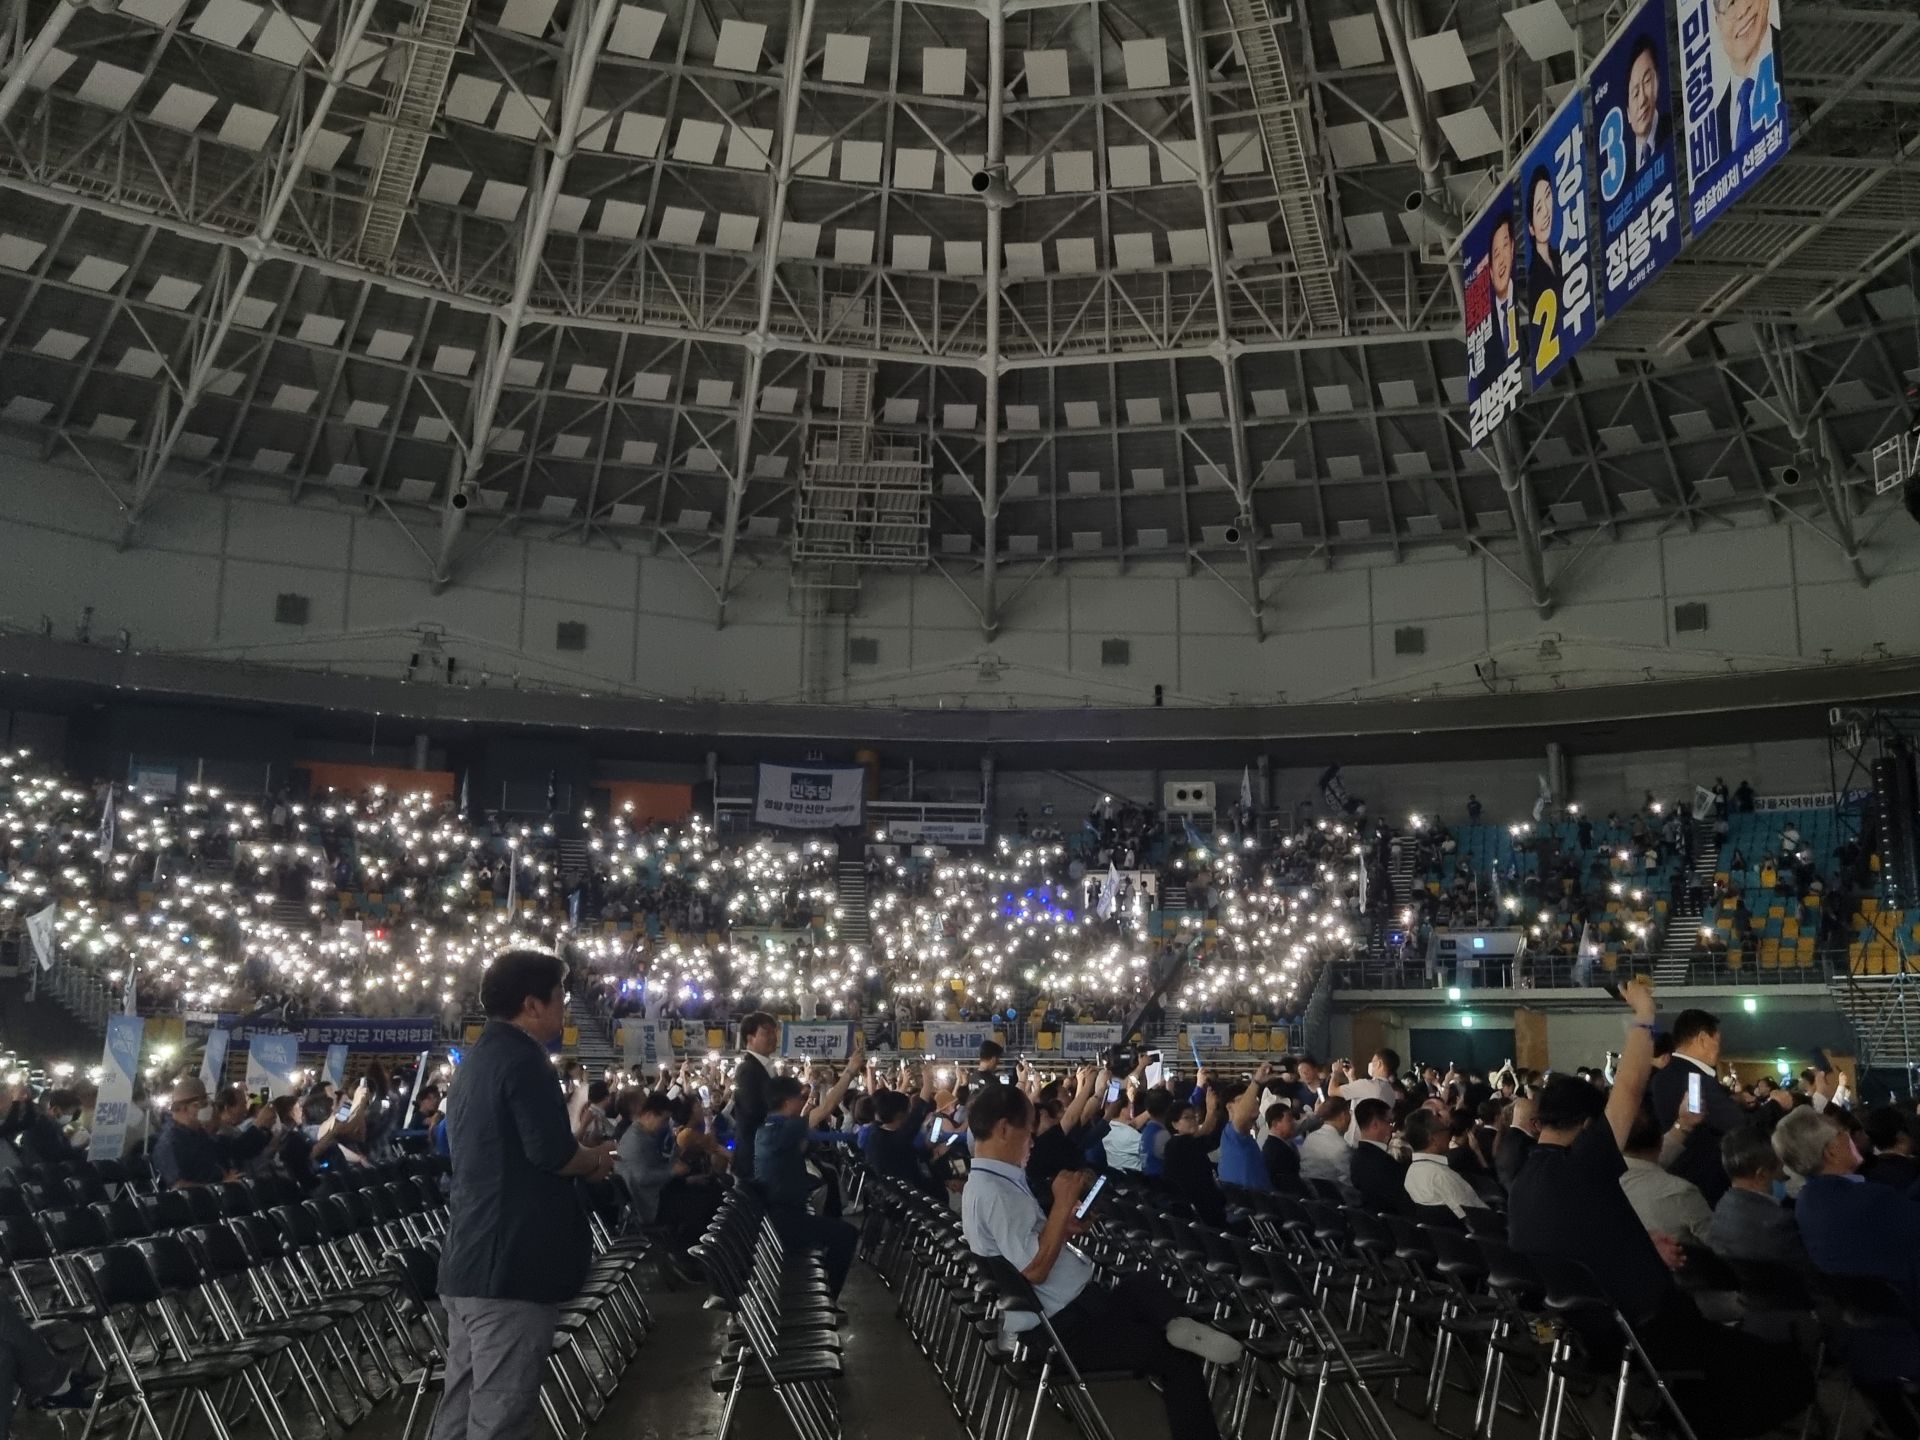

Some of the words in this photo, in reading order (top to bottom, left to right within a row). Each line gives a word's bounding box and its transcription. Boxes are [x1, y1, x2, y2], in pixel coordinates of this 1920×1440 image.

[1683, 0, 1718, 180] 민형배
[1750, 52, 1781, 132] 4
[1599, 106, 1626, 201] 3
[1694, 163, 1740, 223] 검찰해체
[1742, 120, 1783, 179] 선봉장!
[1555, 123, 1590, 336] 강선우
[1606, 192, 1633, 234] 지금은
[1606, 182, 1675, 291] 정봉주
[1469, 346, 1486, 383] 사람
[1507, 305, 1519, 359] 1
[1532, 288, 1560, 375] 2
[1470, 357, 1522, 448] 김병주
[784, 802, 803, 813] 무안
[805, 804, 825, 814] 신안
[791, 784, 832, 799] 민주당
[372, 1028, 432, 1043] 지역위원회
[794, 1034, 817, 1048] 순천
